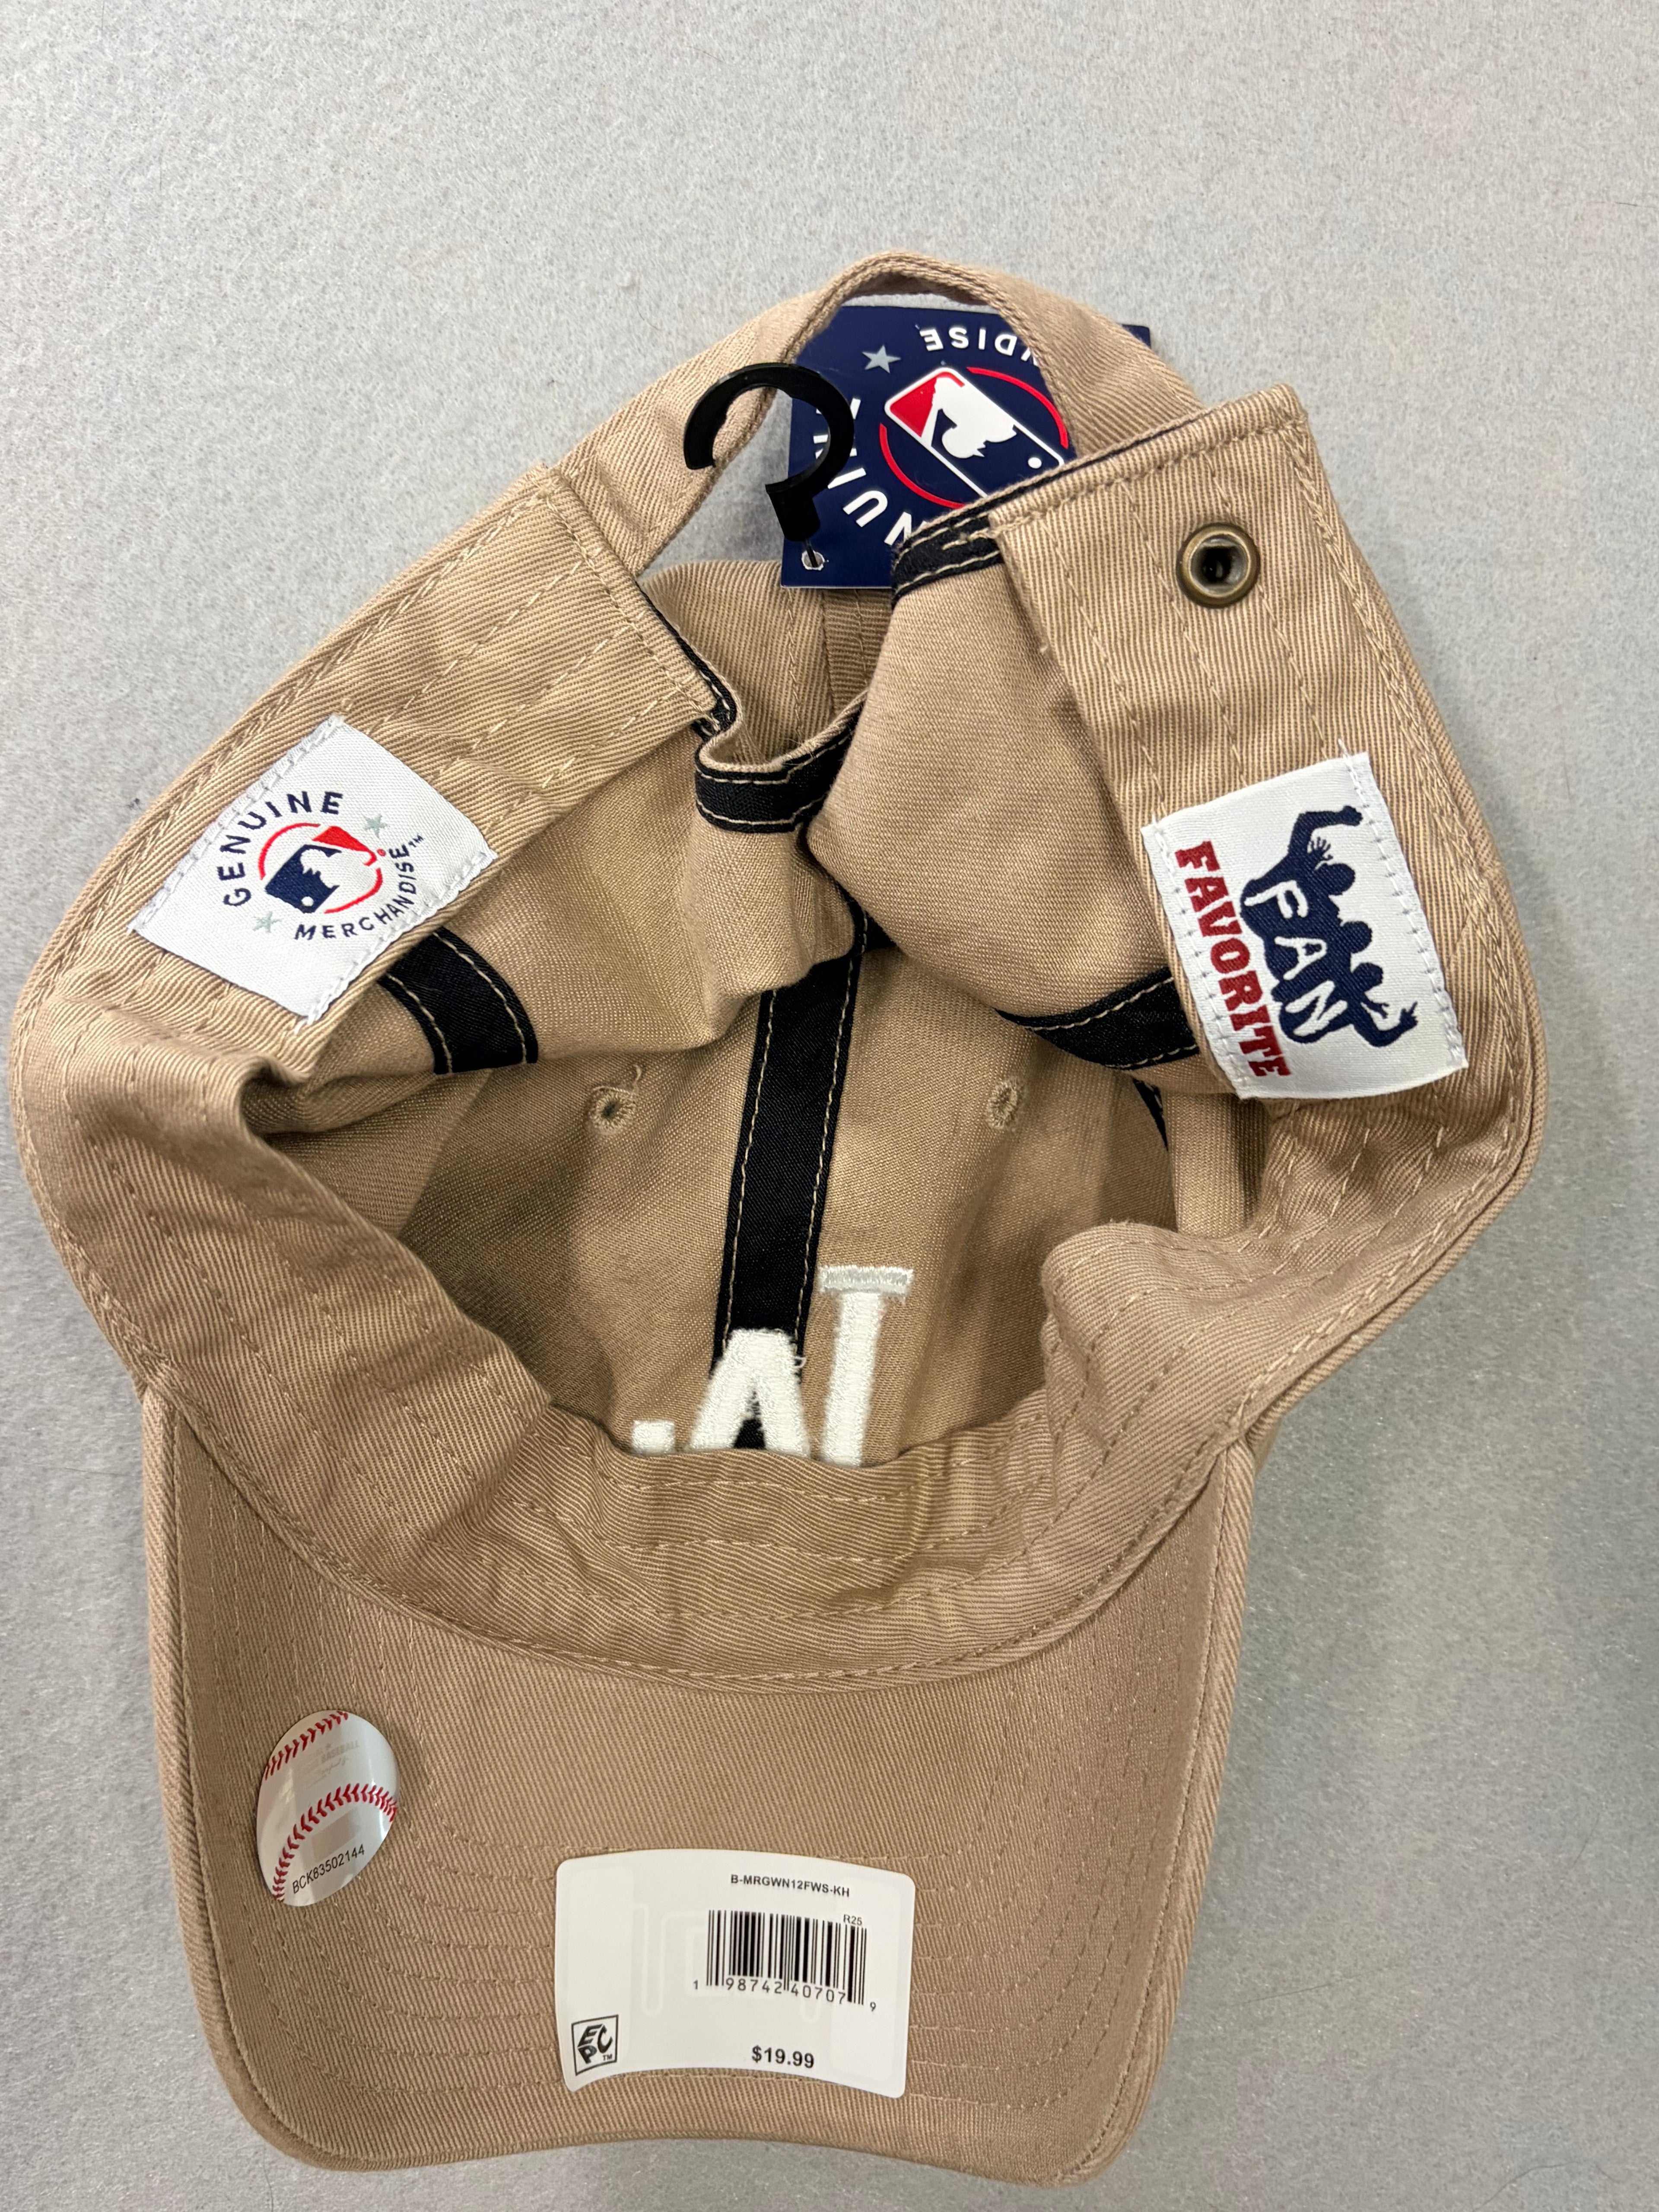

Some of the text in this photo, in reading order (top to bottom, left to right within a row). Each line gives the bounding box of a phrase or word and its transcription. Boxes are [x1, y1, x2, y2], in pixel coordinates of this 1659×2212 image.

[217, 790, 344, 907] GENUINE
[1174, 840, 1291, 1077] FAVORITE
[1244, 879, 1349, 1037] FAN
[292, 1843, 365, 1894] BCK83502144
[731, 1874, 850, 1897] B-MRGWN12FWS-KH
[843, 1914, 862, 1926] R25
[751, 2045, 815, 2069] $19.99
